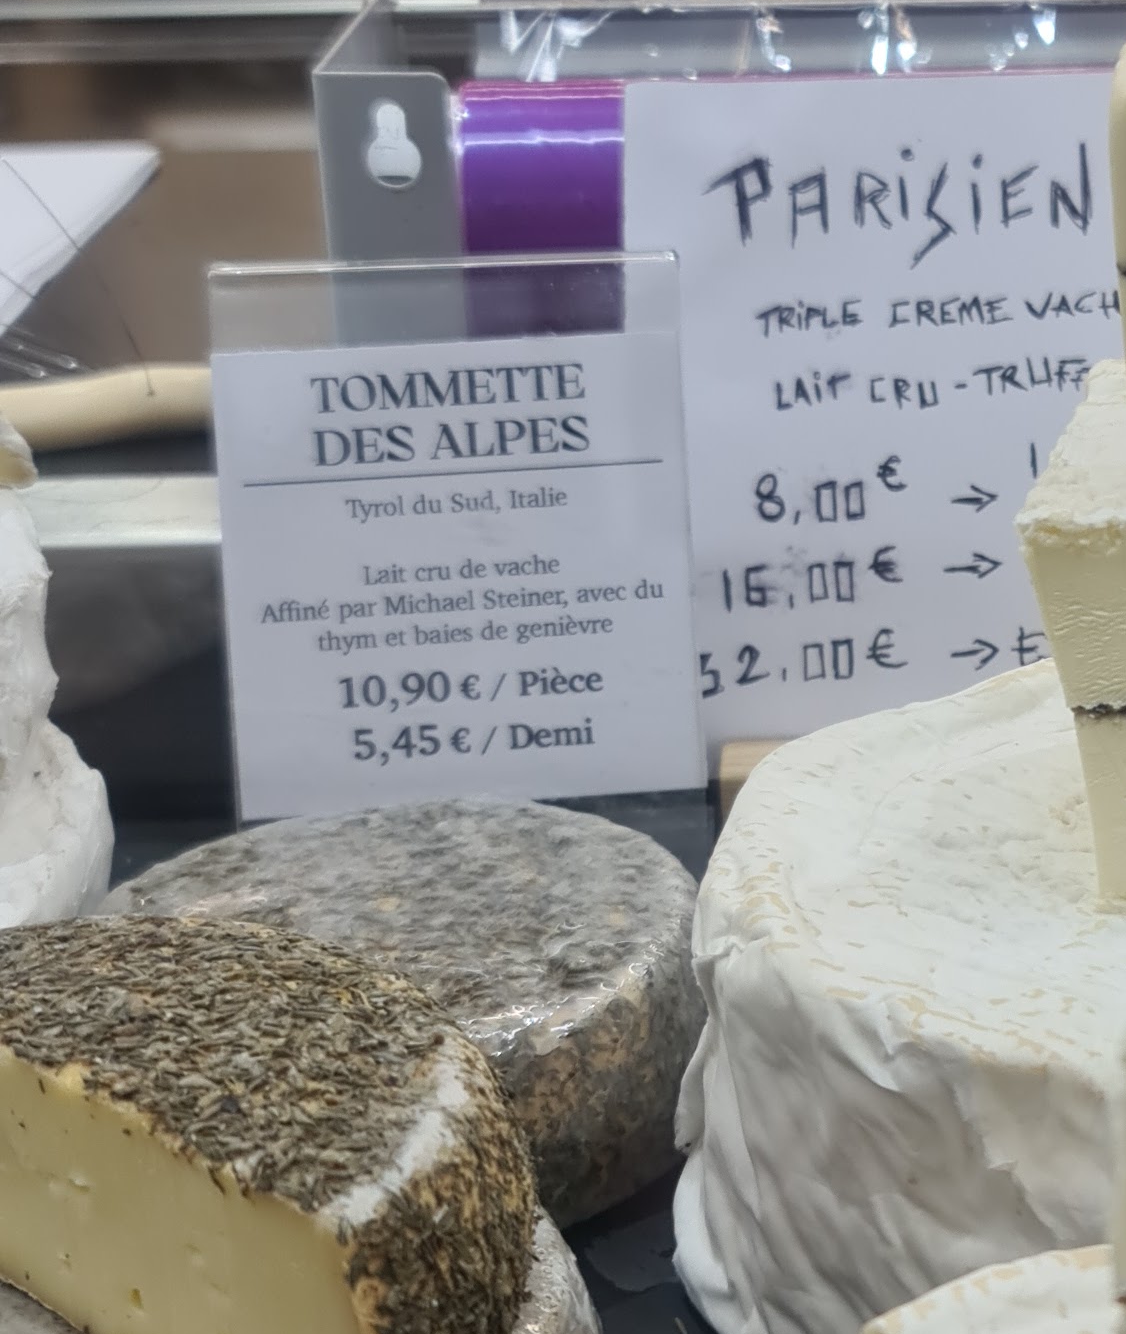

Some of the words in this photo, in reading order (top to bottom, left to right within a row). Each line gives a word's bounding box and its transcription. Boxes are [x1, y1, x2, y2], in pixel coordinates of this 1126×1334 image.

[888, 296, 1014, 328] CREME
[1025, 290, 1121, 320] VACH
[310, 363, 585, 413] TOMMETTE
[870, 377, 939, 410] CRU
[972, 357, 1090, 396] TRUFF
[313, 425, 415, 466] DES
[430, 415, 590, 460] ALPES
[345, 495, 404, 524] Tyrol
[412, 494, 443, 515] du
[450, 490, 502, 515] Sud,
[510, 486, 568, 510] Italie
[362, 563, 408, 586] Lait
[414, 565, 451, 582] cru
[459, 558, 488, 579] de
[494, 554, 561, 577] vache
[260, 598, 330, 624] Affiné
[338, 600, 378, 625] par
[383, 589, 475, 616] Michael
[482, 587, 569, 611] Steiner,
[576, 584, 627, 603] avec
[634, 578, 665, 600] du
[317, 629, 378, 657] thym
[384, 630, 407, 648] et
[413, 623, 474, 646] baies
[480, 619, 509, 641] de
[515, 614, 614, 645] genièvre
[518, 667, 604, 697] Pièce
[508, 717, 596, 750] Demi
